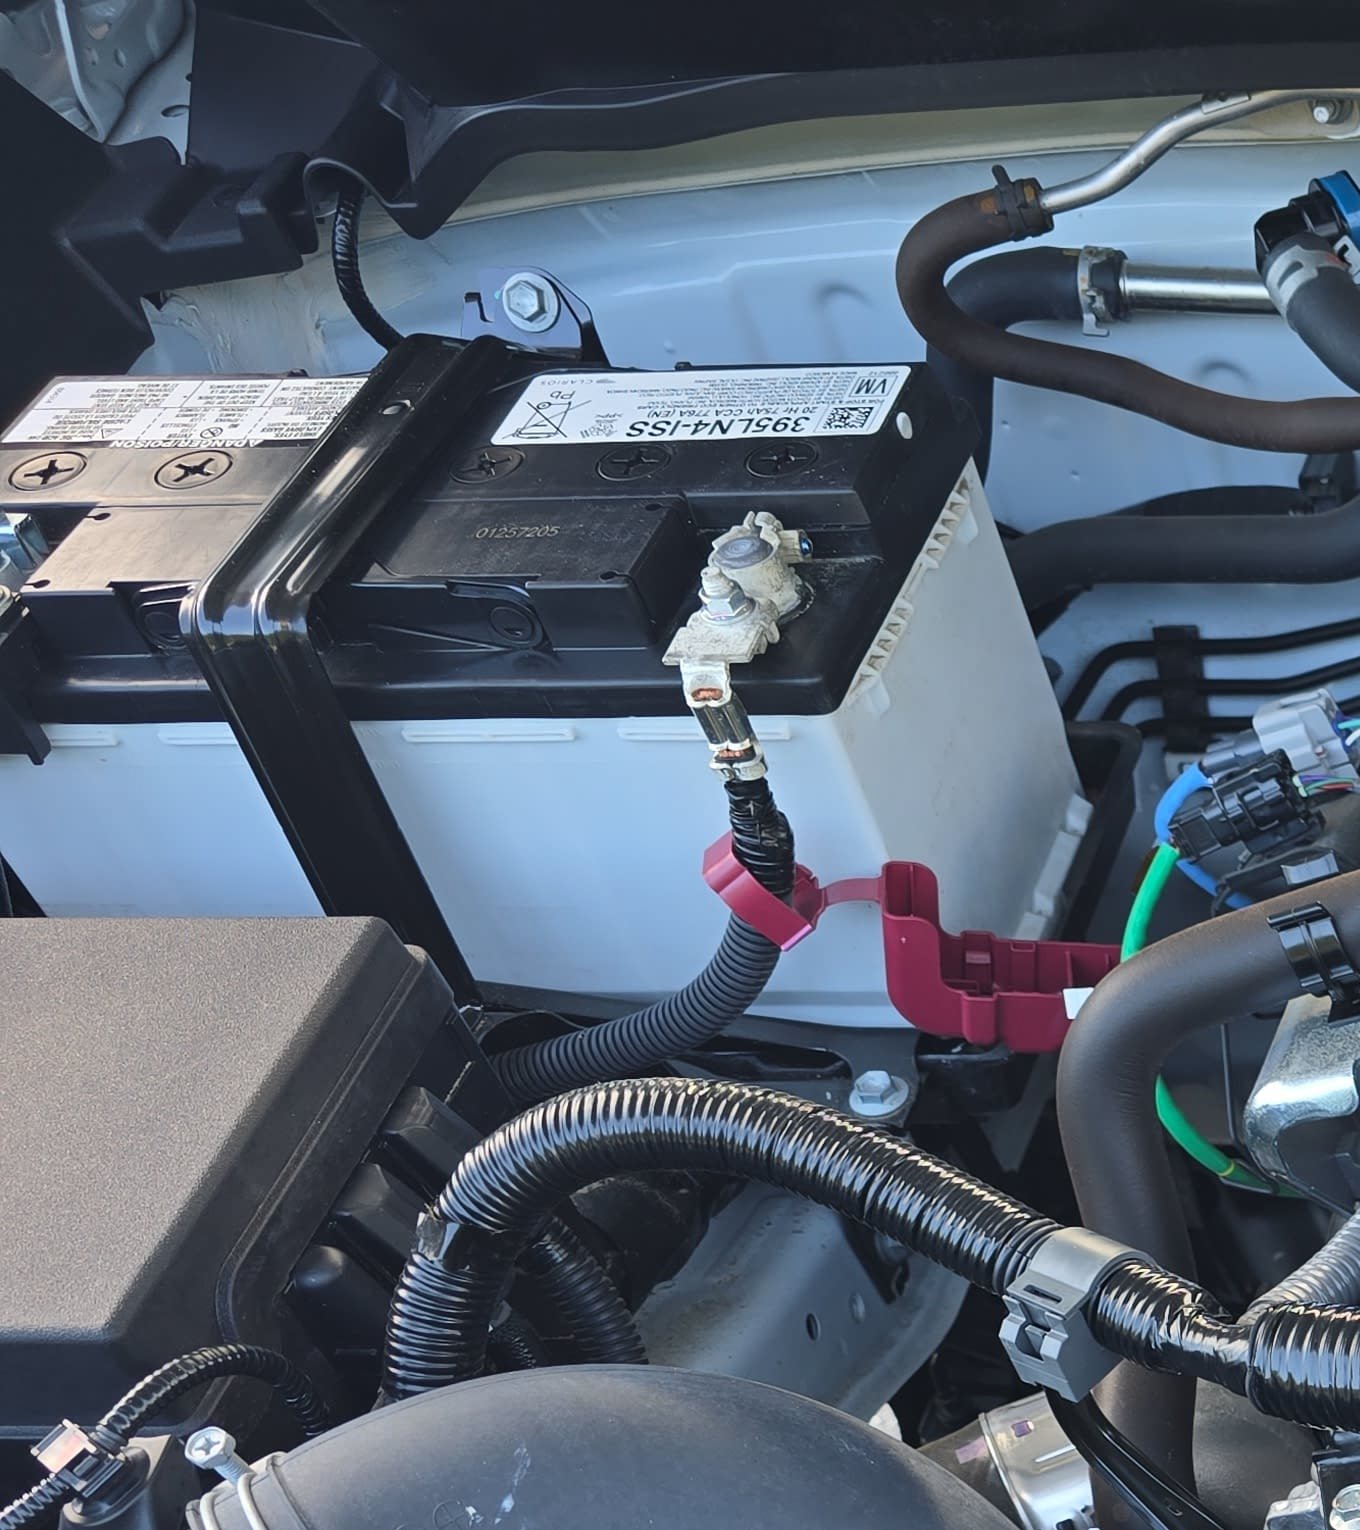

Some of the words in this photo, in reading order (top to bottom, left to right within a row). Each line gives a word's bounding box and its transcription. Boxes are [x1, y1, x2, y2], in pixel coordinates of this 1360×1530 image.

[853, 378, 889, 394] VM
[548, 390, 576, 400] Pb
[647, 409, 676, 419] (EN)
[679, 409, 711, 417] 776A
[714, 408, 743, 416] CCA
[747, 407, 780, 416] 75Ah
[782, 406, 800, 415] Hr
[801, 406, 818, 414] 20
[625, 416, 810, 438] 395LN4-ISS
[110, 439, 248, 448] DANGER/POISON
[475, 526, 560, 539] 01257205
